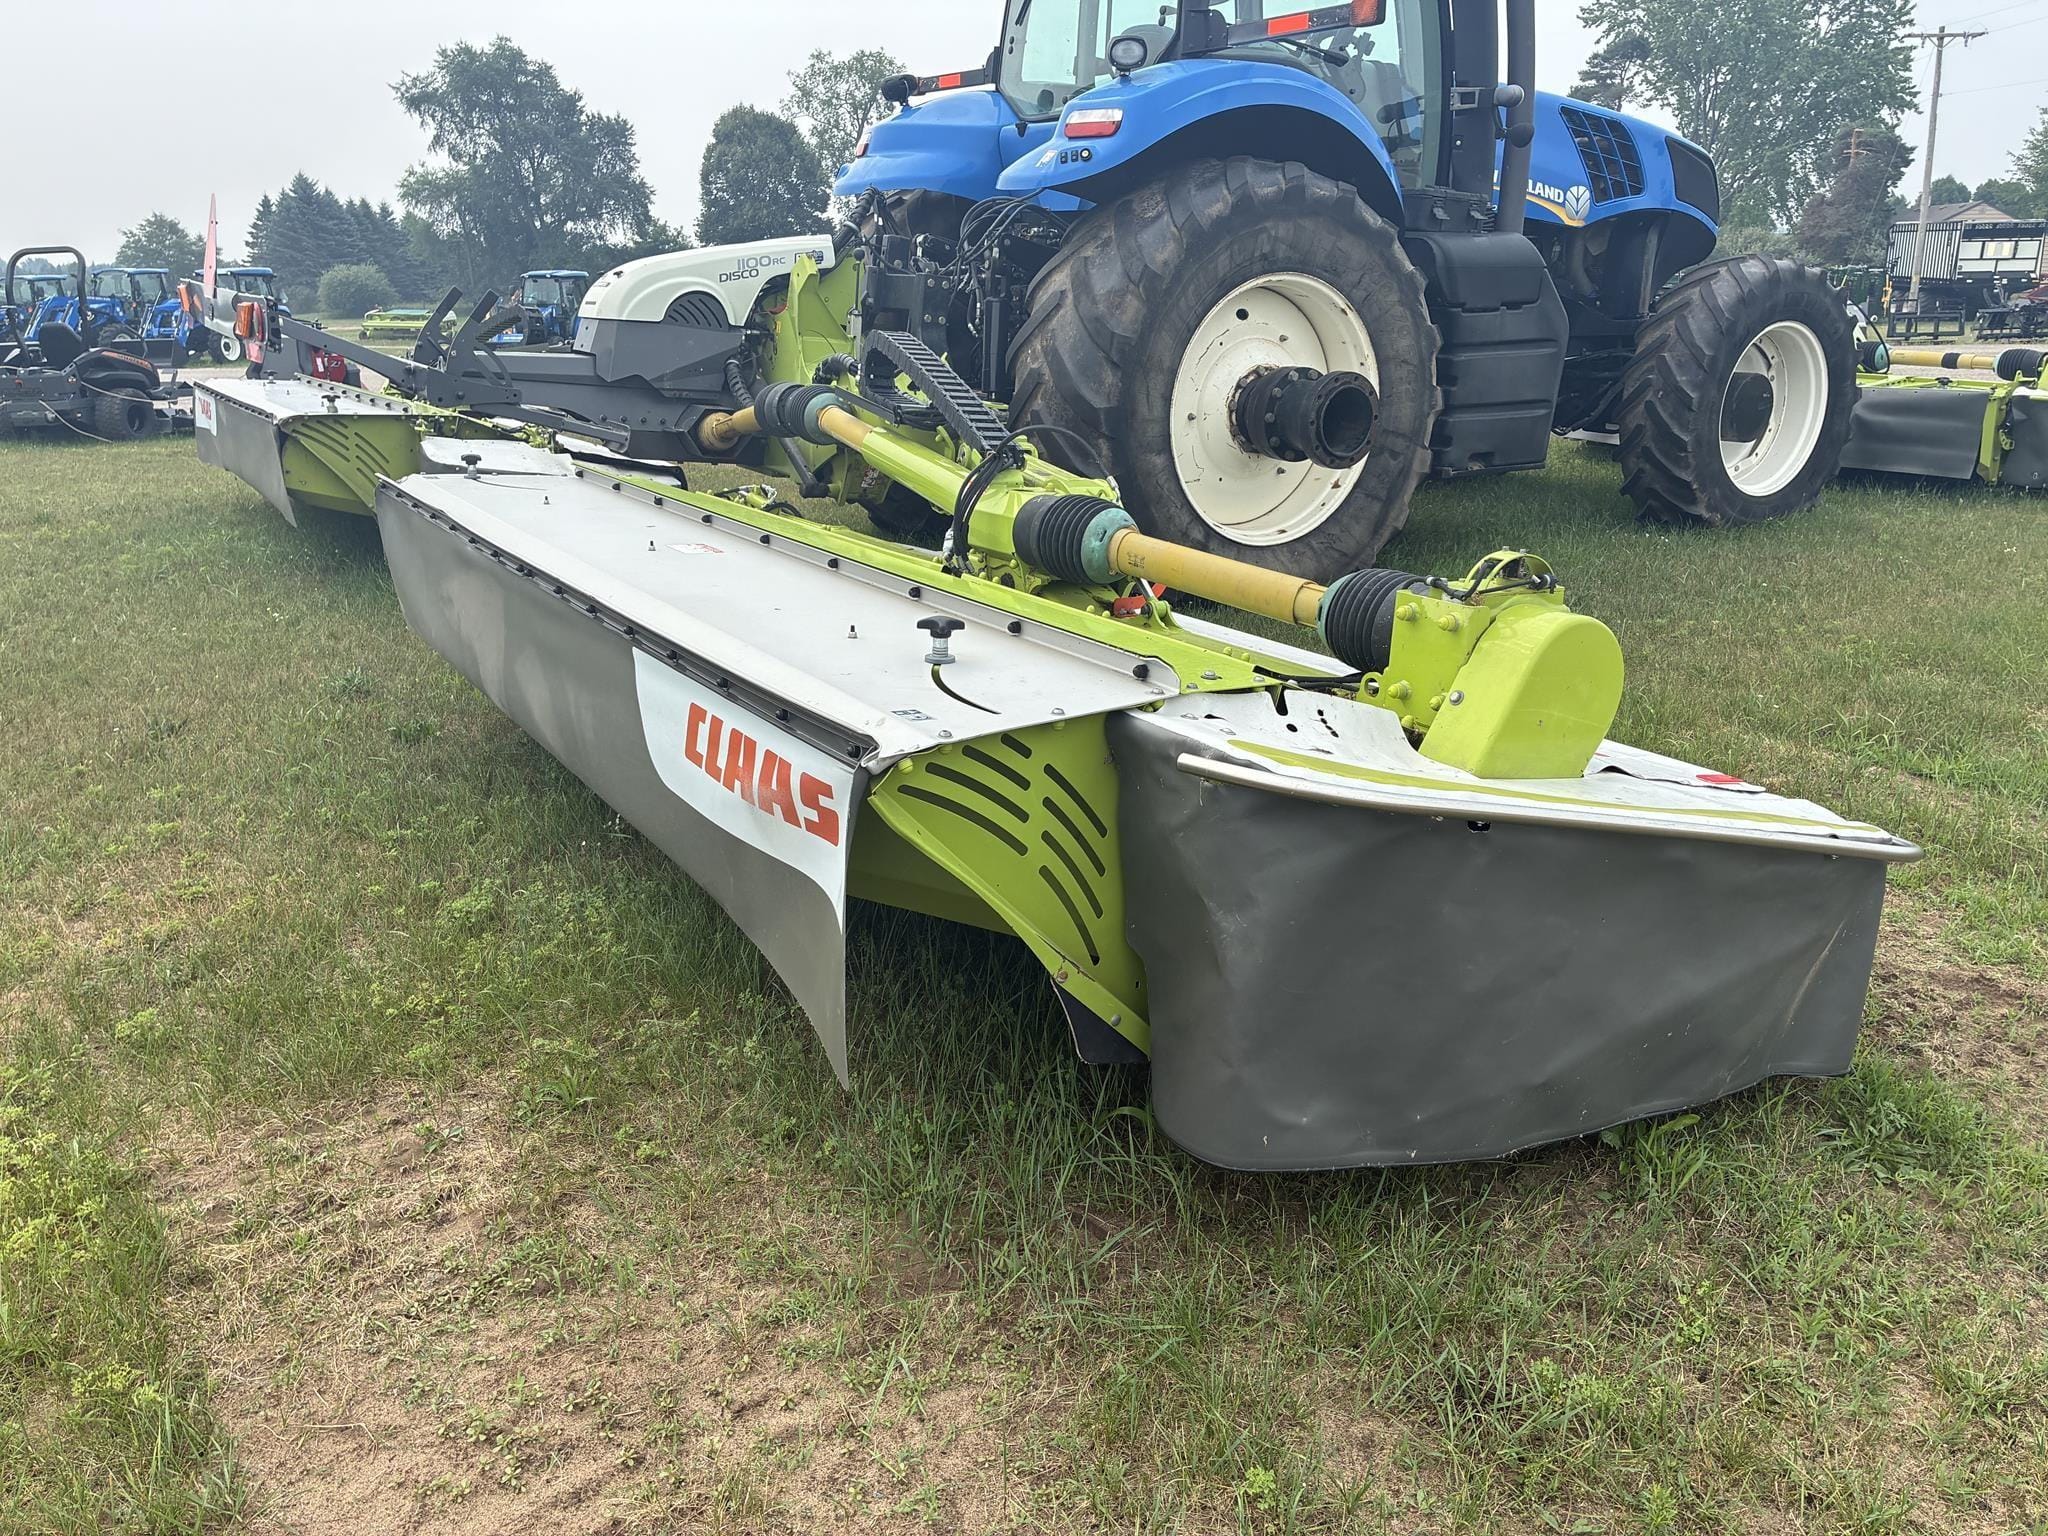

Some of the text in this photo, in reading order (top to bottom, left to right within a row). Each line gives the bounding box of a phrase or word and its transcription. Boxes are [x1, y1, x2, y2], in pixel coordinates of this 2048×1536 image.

[1527, 179, 1564, 204] LAND
[719, 268, 759, 283] DISCO
[685, 702, 840, 847] CLAAS
